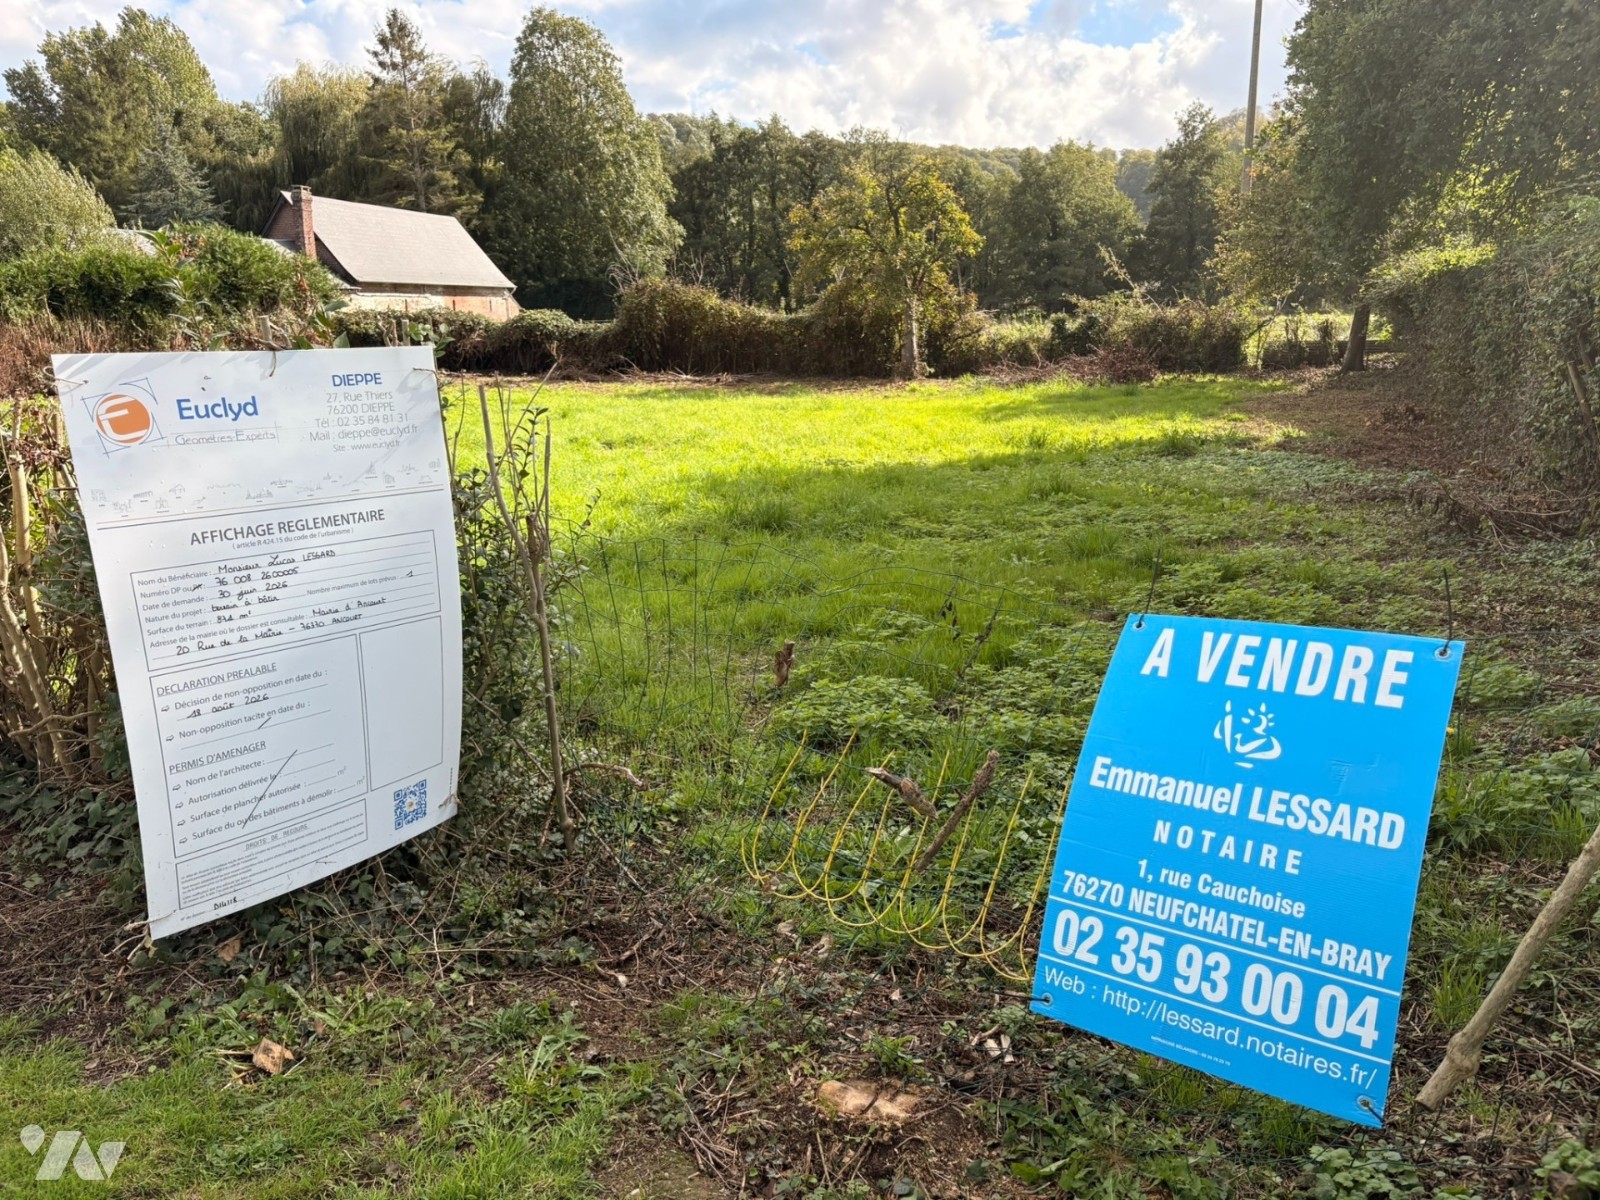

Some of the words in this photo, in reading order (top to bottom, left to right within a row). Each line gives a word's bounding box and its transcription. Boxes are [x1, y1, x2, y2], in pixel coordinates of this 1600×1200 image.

[332, 373, 382, 387] DIEPPE
[344, 392, 363, 402] Rue
[365, 391, 393, 401] Thiers
[176, 396, 259, 421] Euclyd
[327, 404, 358, 415] 76200
[361, 402, 395, 413] DIEPPE
[337, 417, 350, 427] 02
[354, 416, 365, 426] 35
[368, 414, 380, 424] 84
[382, 413, 394, 423] 81
[397, 413, 408, 423] 31
[309, 431, 330, 441] Mail
[338, 424, 419, 440] dieppe@euclyd.fr
[333, 444, 346, 453] Site
[351, 440, 400, 451] www.euclyd.fr
[190, 522, 275, 546] AFFICHAGE
[278, 509, 385, 534] REGLEMENTAIRE
[237, 540, 256, 549] article
[294, 533, 308, 541] code
[318, 529, 351, 538] l'urbanisme
[218, 563, 261, 574] Monsieur
[268, 554, 296, 567] Lucas
[138, 579, 156, 587] Nom
[168, 572, 209, 582] Bénéficiaire
[215, 577, 228, 586] 76
[234, 574, 252, 584] 008
[307, 587, 331, 596] Nombre
[332, 582, 359, 590] maximum
[379, 576, 397, 584] prévus
[140, 588, 170, 599] Numéro
[218, 590, 231, 599] 30
[237, 587, 257, 600] juin
[265, 581, 288, 591] 2026
[172, 597, 205, 607] demande
[212, 602, 239, 612] terrain
[258, 595, 280, 604] bâtir
[312, 606, 339, 617] Mairie
[357, 597, 387, 608] Ancourt
[145, 614, 172, 623] Nature
[182, 609, 203, 619] projet
[147, 627, 174, 636] Surface
[186, 620, 209, 629] terrain
[150, 638, 177, 648] Adresse
[197, 631, 218, 640] mairie
[236, 623, 259, 632] dossier
[270, 614, 305, 626] consultable
[176, 645, 190, 656] 20
[197, 640, 216, 651] Rue
[220, 639, 232, 647] de
[238, 634, 248, 643] la
[300, 621, 325, 630] 76370
[1140, 628, 1175, 678] A
[1196, 631, 1415, 709] VENDRE
[156, 673, 225, 697] DECLARATION
[226, 662, 278, 681] PREALABLE
[174, 697, 211, 710] Décision
[212, 693, 223, 702] de
[224, 679, 284, 699] non-opposition
[284, 676, 294, 684] en
[295, 673, 312, 682] date
[312, 670, 323, 678] du
[211, 702, 235, 713] août
[244, 693, 270, 706] 2026
[178, 715, 244, 739] Non-opposition
[244, 713, 265, 723] tacite
[277, 704, 294, 714] date
[168, 757, 205, 774] PERMIS
[205, 740, 267, 765] D'AMENAGER
[185, 775, 206, 787] Nom
[207, 772, 218, 780] de
[188, 785, 237, 805] Autorisation
[238, 775, 269, 790] délivrée
[190, 808, 221, 822] Surface
[221, 804, 232, 813] de
[233, 795, 266, 811] plancher
[268, 782, 301, 798] autorisée
[1089, 755, 1243, 816] Emmanuel
[1248, 787, 1405, 850] LESSARD
[192, 825, 223, 840] Surface
[224, 821, 235, 830] du
[248, 812, 262, 822] des
[263, 800, 300, 817] bâtiments
[245, 837, 267, 851] DROITS
[270, 833, 279, 841] DE
[282, 824, 308, 837] RECOURS
[1153, 820, 1302, 875] NOTAIRE
[1138, 859, 1153, 883] 1,
[1159, 867, 1191, 889] rue
[1197, 873, 1306, 919] Cauchoise
[1062, 870, 1124, 907] 76270
[1127, 887, 1392, 981] NEUFCHATEL-EN-BRAY
[1052, 909, 1103, 966] 02
[1111, 926, 1166, 983] 35
[1173, 944, 1231, 1004] 93
[1241, 963, 1304, 1025] 00
[1314, 984, 1380, 1050] 04
[1043, 965, 1085, 995] Web
[1102, 984, 1377, 1090] http://lessard.notaires.fr/
